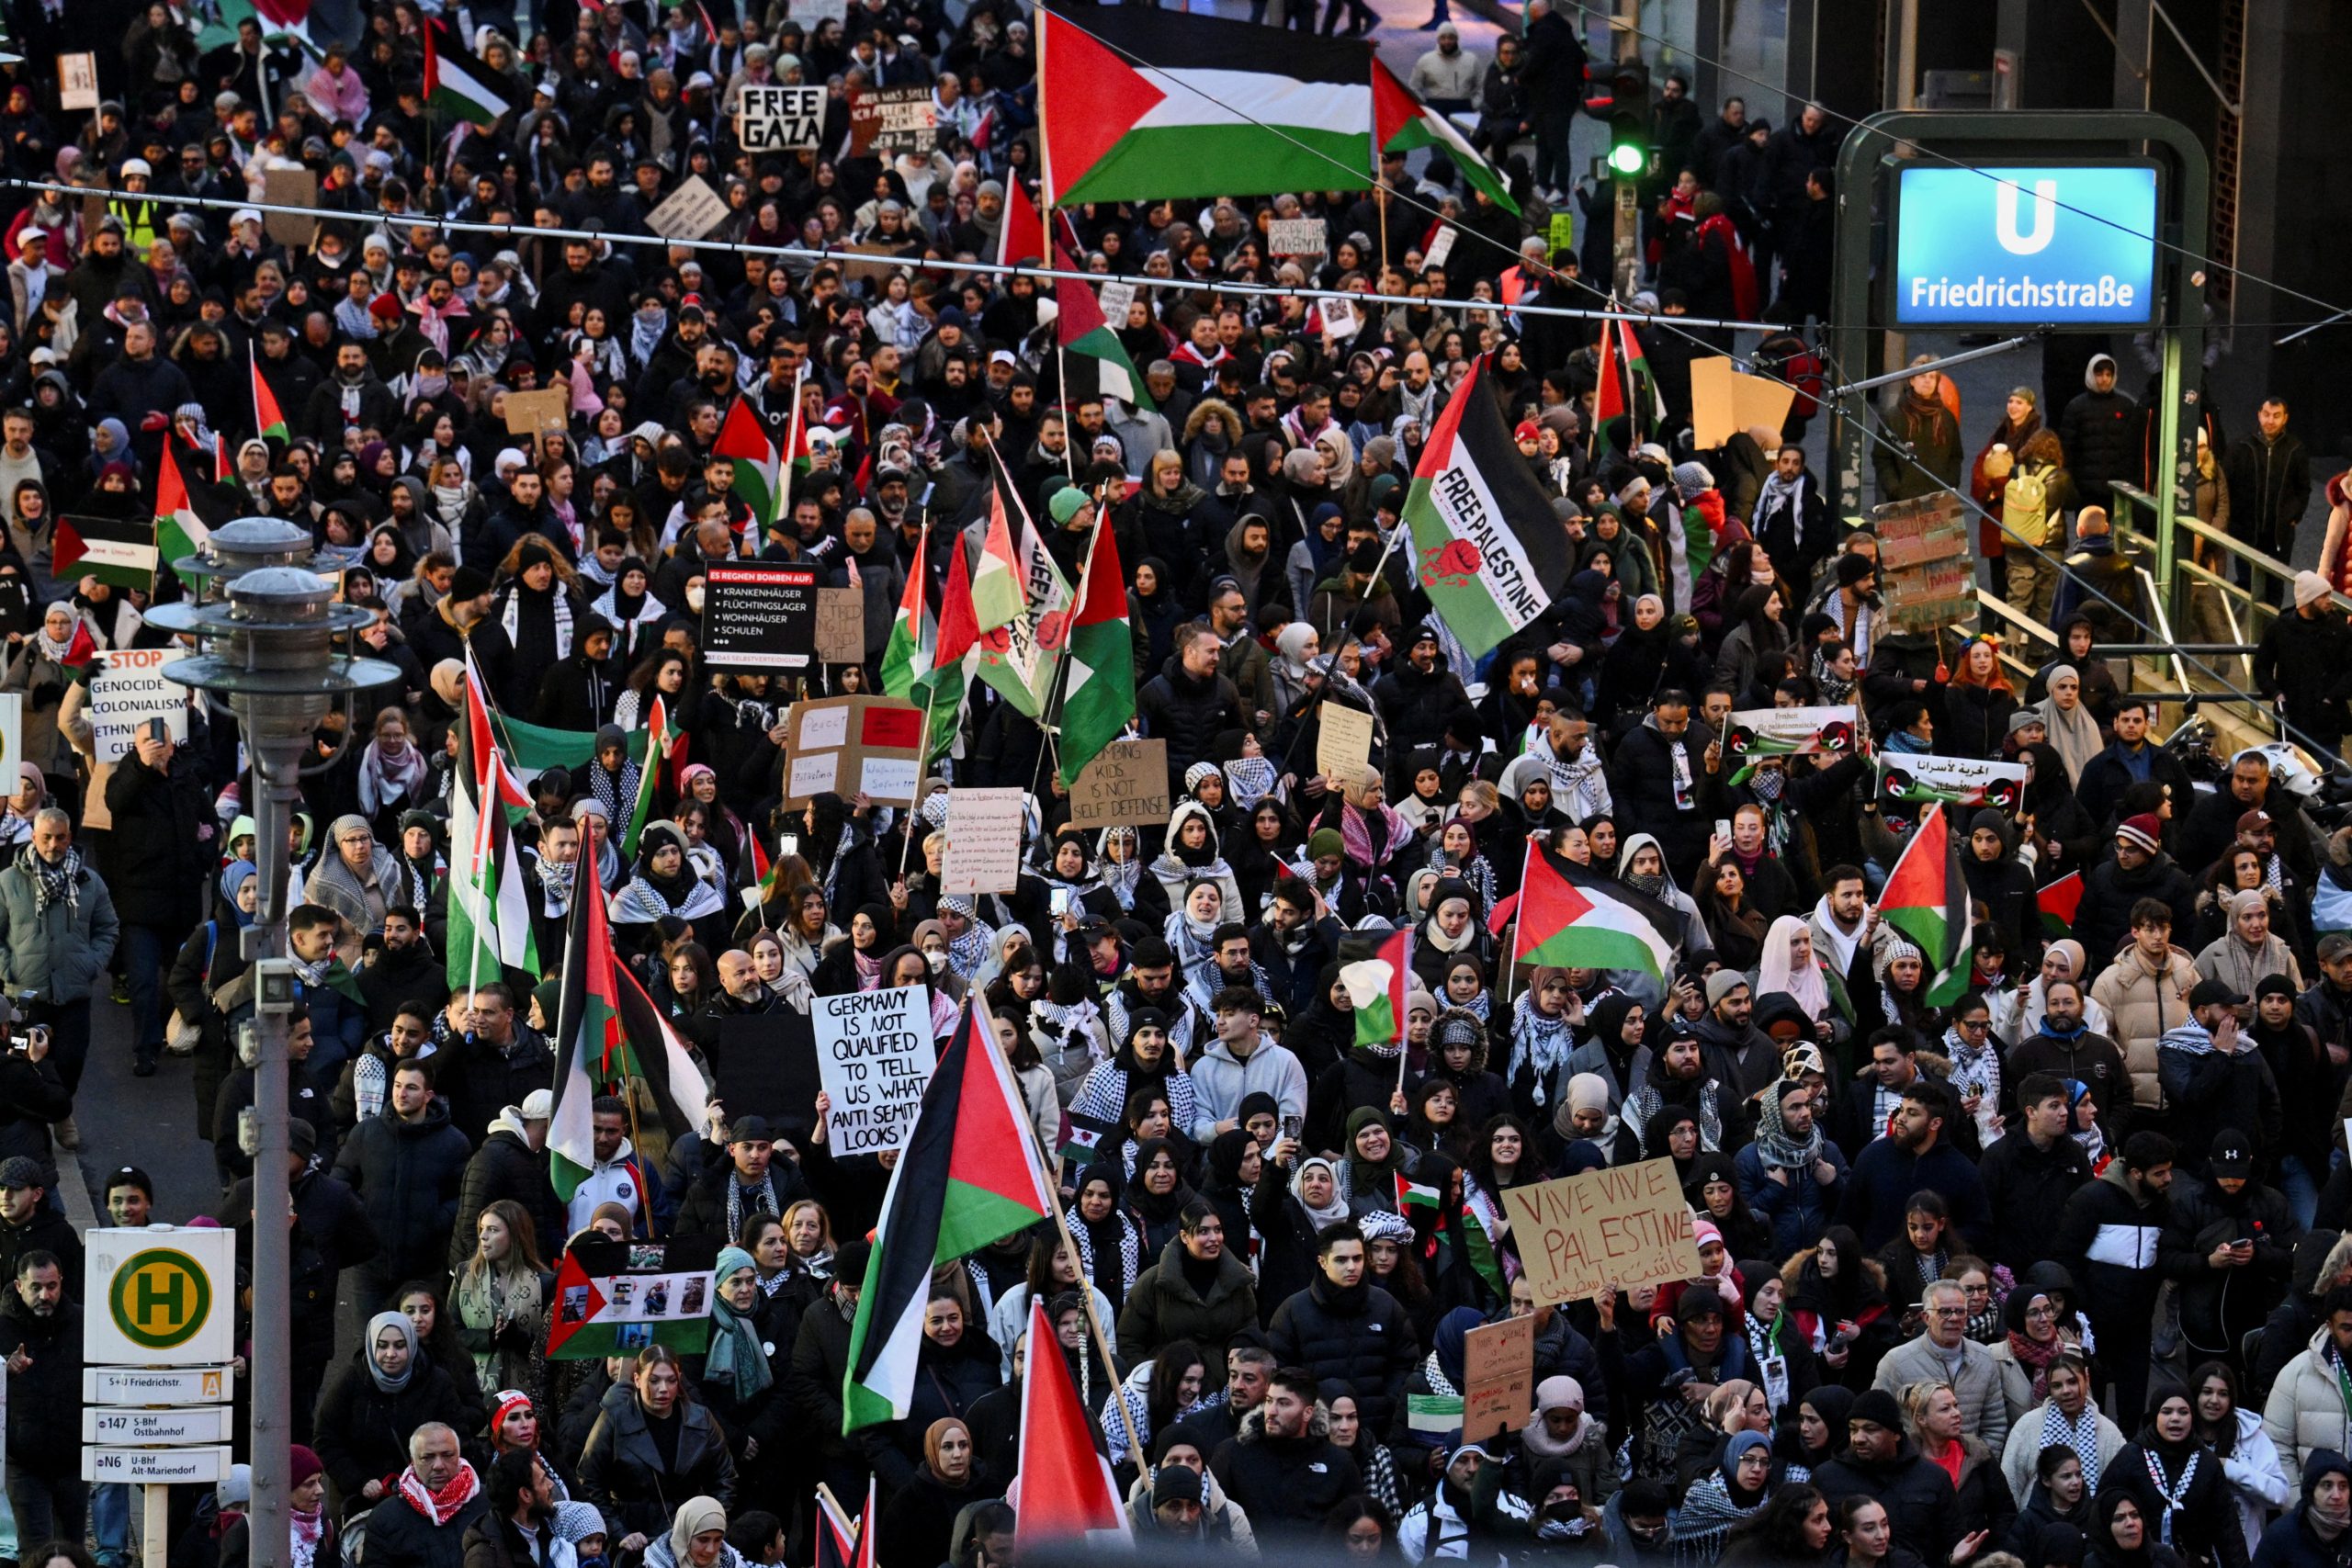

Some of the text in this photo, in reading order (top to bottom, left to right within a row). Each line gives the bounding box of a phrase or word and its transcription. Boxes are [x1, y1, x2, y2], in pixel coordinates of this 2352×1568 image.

[744, 89, 820, 117] FREE
[743, 118, 821, 147] GAZA
[1996, 179, 2057, 255] U
[1911, 275, 2134, 308] Friedrichstraße
[1439, 466, 1482, 524] FREE
[1466, 512, 1542, 621] PALESTINE
[710, 571, 813, 583] ES REGNEN BOMBEN AUF:
[723, 587, 802, 598] KRANKENHÄUSER
[721, 613, 787, 624] WOHNHÄUSER
[721, 626, 763, 636] SCHULEN
[109, 650, 164, 670] STOP
[92, 680, 164, 694] GENOCIDE
[93, 698, 187, 714] COLONIALISM
[95, 724, 137, 738] ETHNI
[1093, 743, 1141, 761] OMBING
[1095, 763, 1124, 779] KIDS
[1091, 779, 1136, 798] IS NOT
[1073, 795, 1169, 819] SELF DEFENSE
[828, 989, 909, 1017] GERMANY
[843, 1013, 907, 1036] IS NOT
[832, 1032, 919, 1061] QUALIFIED
[841, 1057, 922, 1081] TO TELL
[845, 1077, 929, 1104] US WHAT
[831, 1101, 919, 1129] ANTI SEMIT
[843, 1125, 899, 1151] LOOKS
[1544, 1208, 1693, 1280] PALESTINE
[137, 1272, 184, 1325] H
[130, 1377, 182, 1387] Friedrichstr.
[107, 1417, 127, 1429] 147
[133, 1416, 157, 1427] S-Bhf
[133, 1427, 185, 1437] Ostbahnhof
[105, 1456, 121, 1468] N6
[131, 1456, 156, 1465] U-Bhf
[131, 1465, 196, 1475] Alt-Mariendorf
